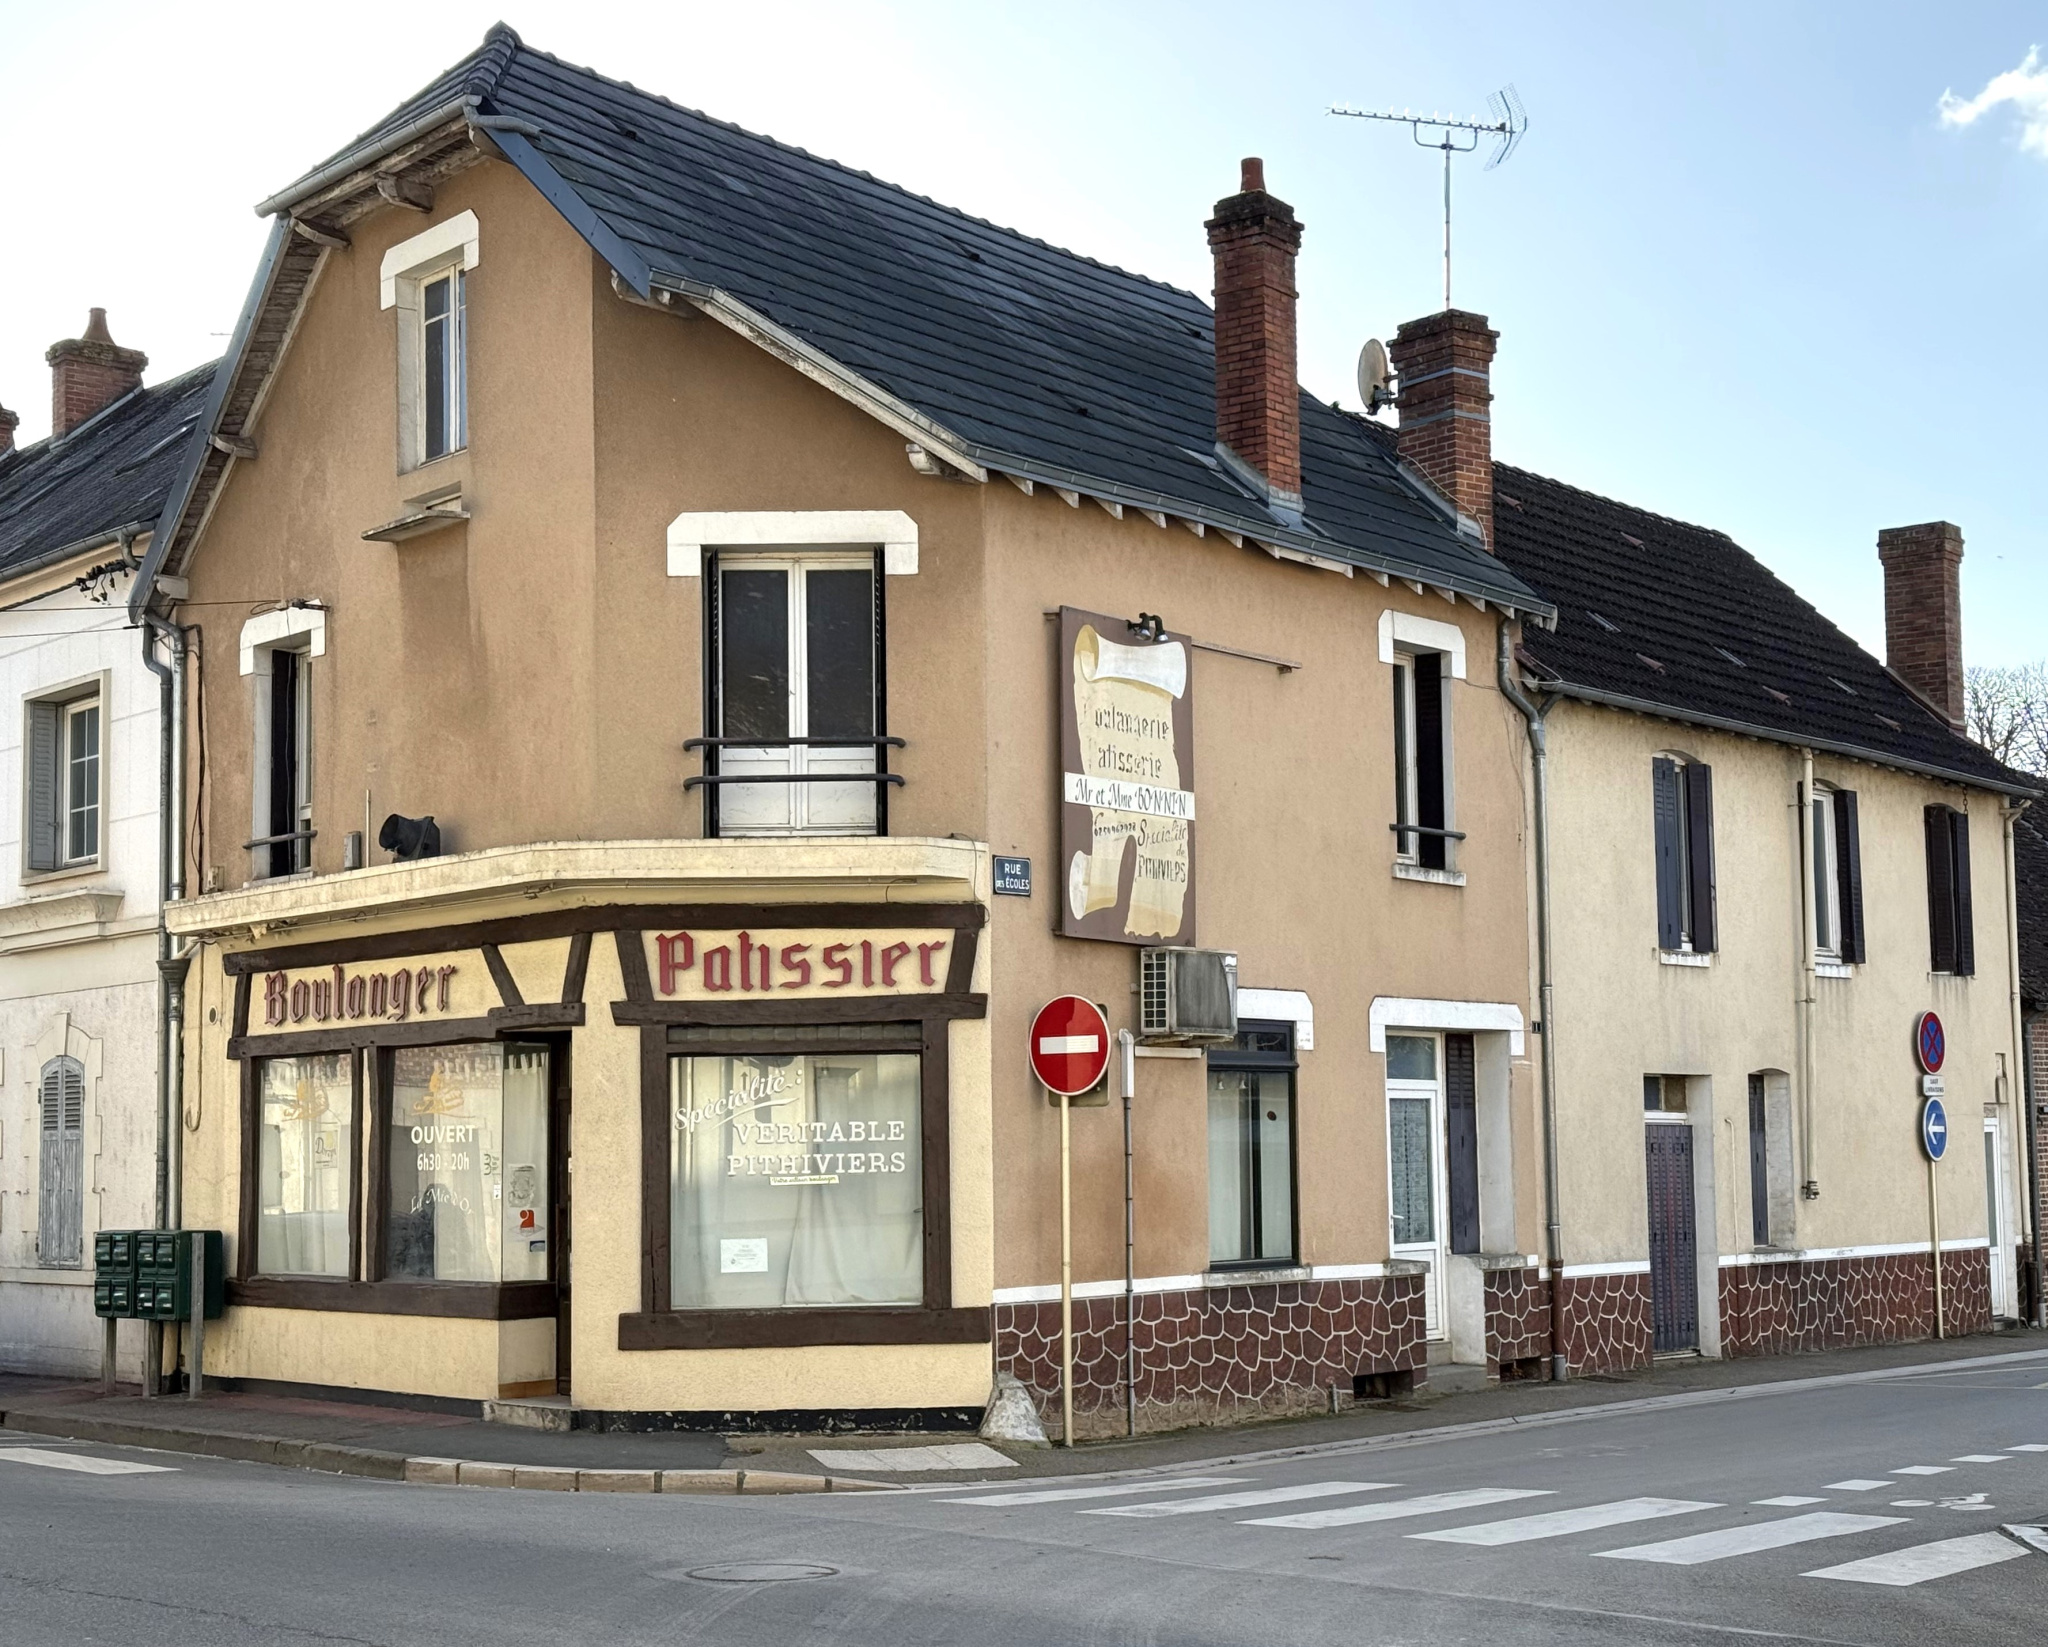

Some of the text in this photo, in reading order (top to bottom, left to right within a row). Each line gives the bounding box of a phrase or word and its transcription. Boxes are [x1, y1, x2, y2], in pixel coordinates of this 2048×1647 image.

[1081, 702, 1169, 740] oulangerie
[1088, 739, 1162, 779] atisserie
[1075, 778, 1186, 816] Mr et Mme BONNIN
[1004, 863, 1022, 875] RUE
[1005, 874, 1030, 890] ÉCOLES
[655, 930, 947, 996] Patissier
[264, 963, 458, 1027] Boulanger
[411, 1125, 475, 1145] OUVERT
[732, 1120, 905, 1144] VERITABLE
[417, 1152, 441, 1171] 6h30
[451, 1151, 470, 1171] 20h
[727, 1152, 906, 1176] PITHIVIERS
